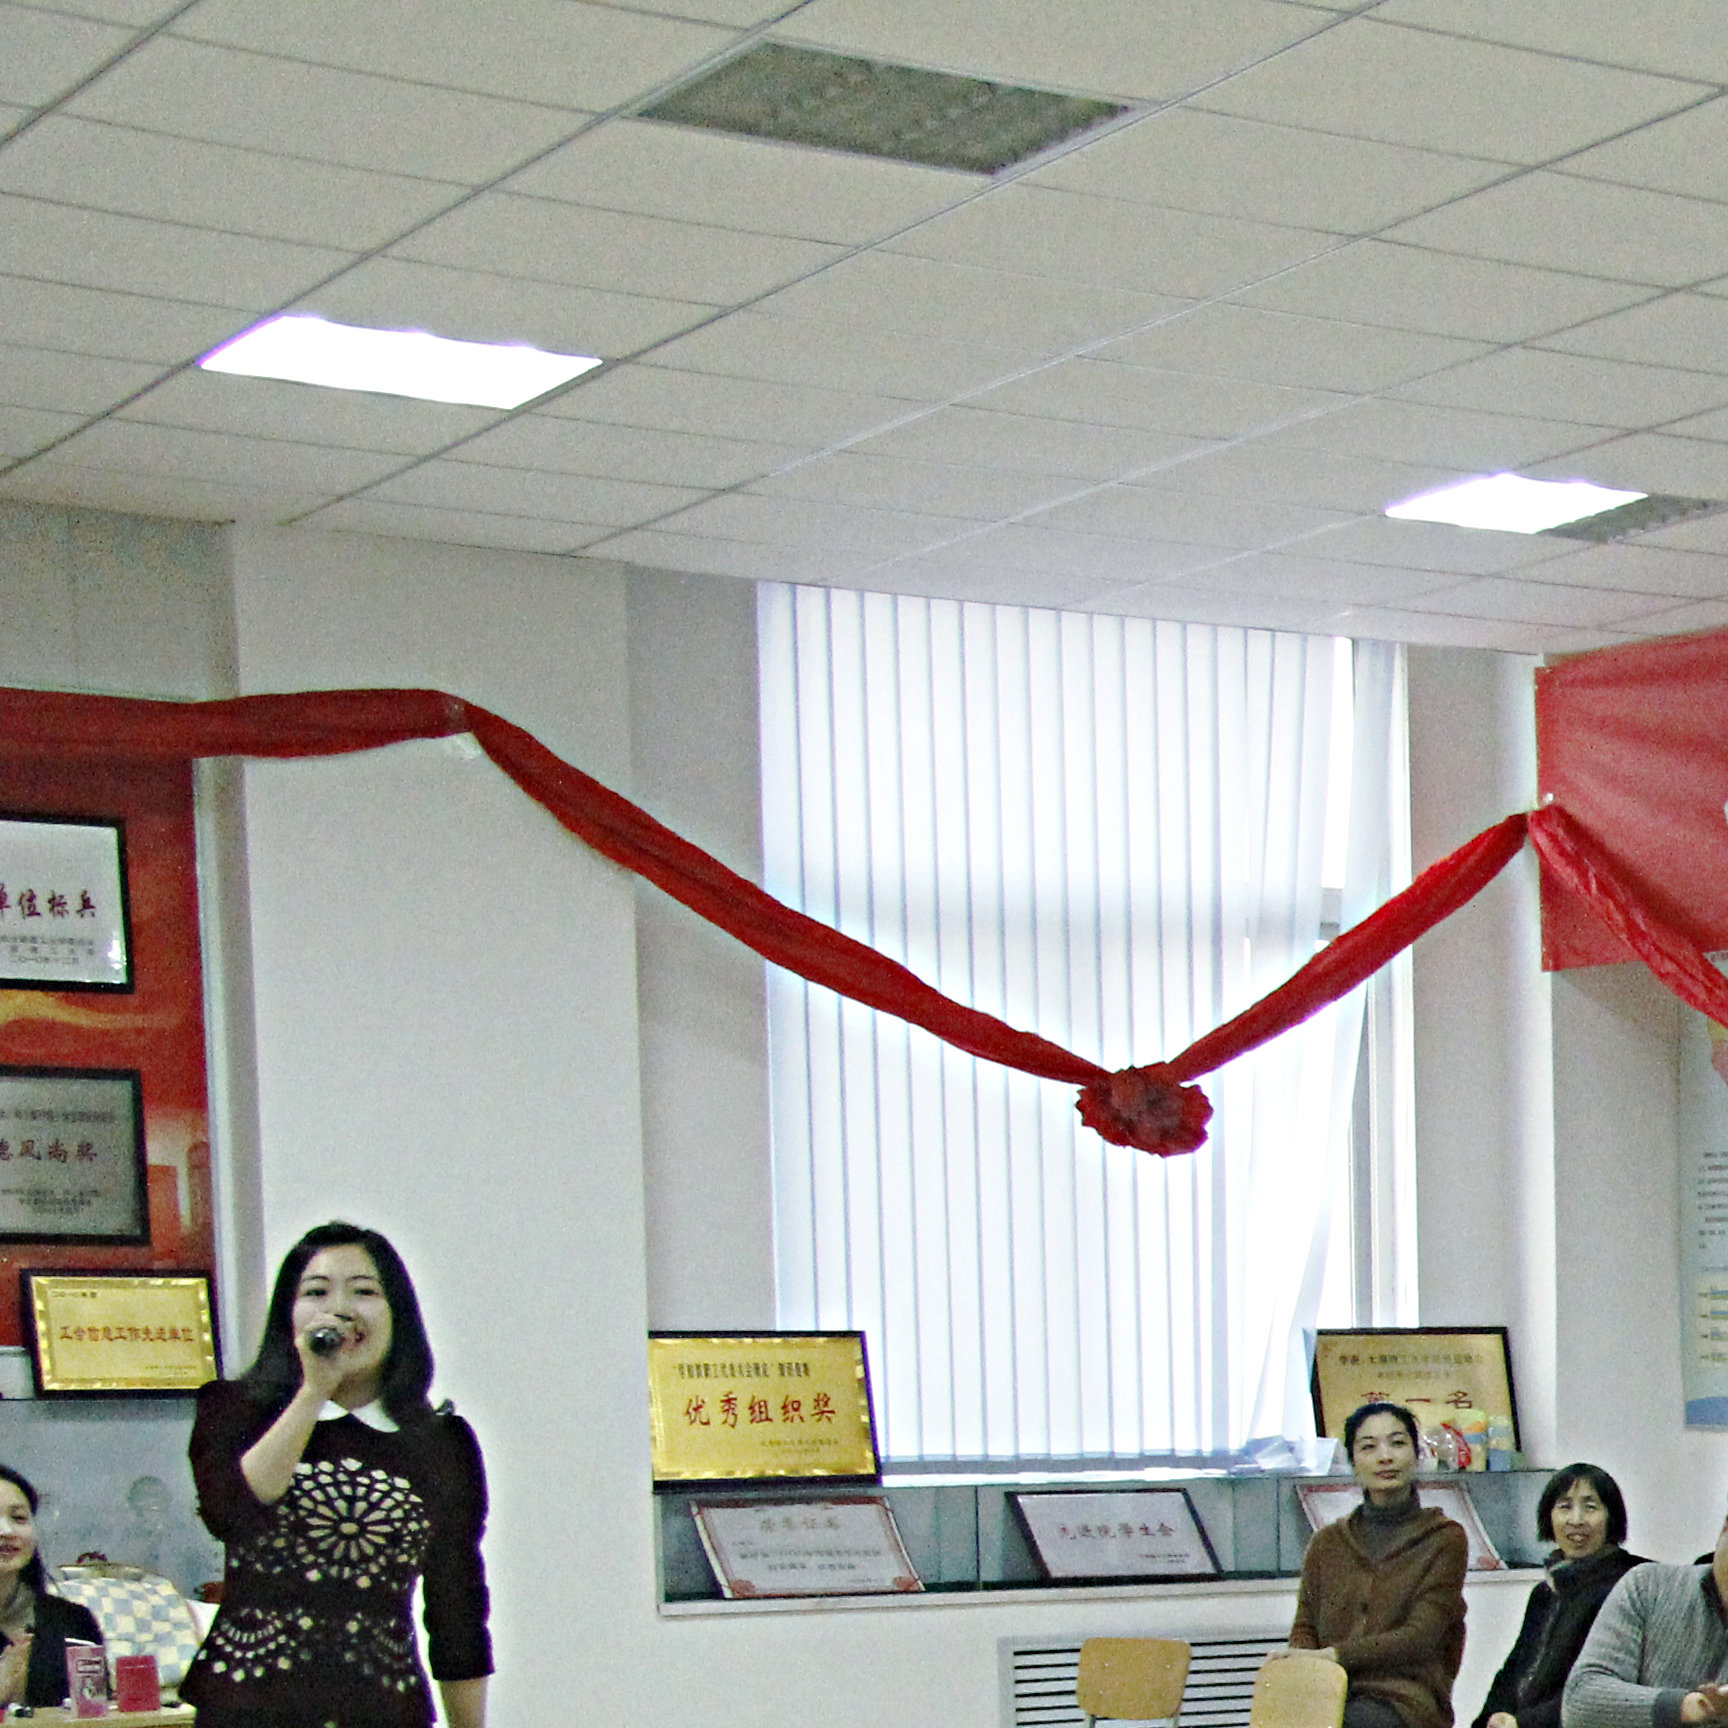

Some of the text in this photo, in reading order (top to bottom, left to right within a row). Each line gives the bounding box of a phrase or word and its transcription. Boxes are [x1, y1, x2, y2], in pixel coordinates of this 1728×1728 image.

[684, 1390, 836, 1428] 优秀组织奖
